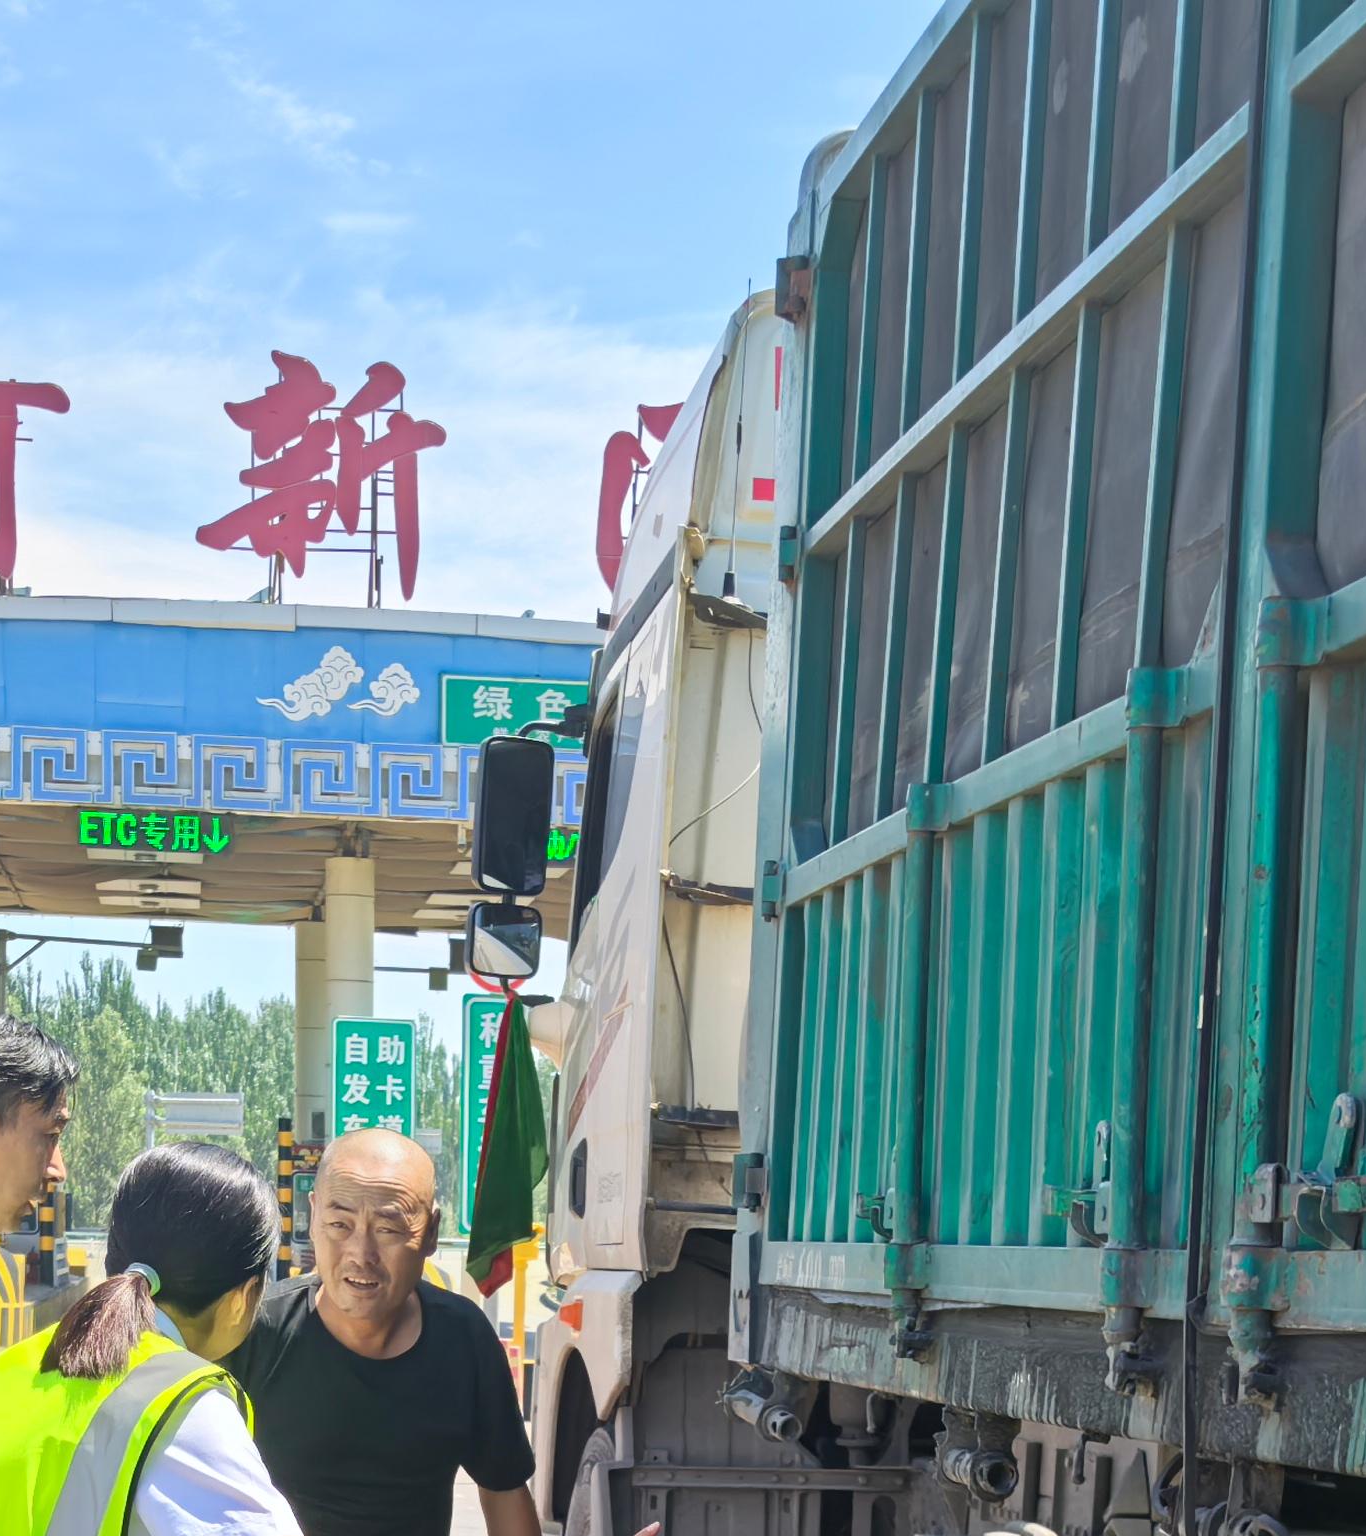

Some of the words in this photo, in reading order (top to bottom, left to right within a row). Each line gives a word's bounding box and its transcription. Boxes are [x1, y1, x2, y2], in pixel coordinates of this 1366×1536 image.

[472, 685, 572, 722] 绿色
[79, 810, 201, 852] ETC专用
[344, 1033, 406, 1066] 自助
[341, 1073, 406, 1106] 发卡
